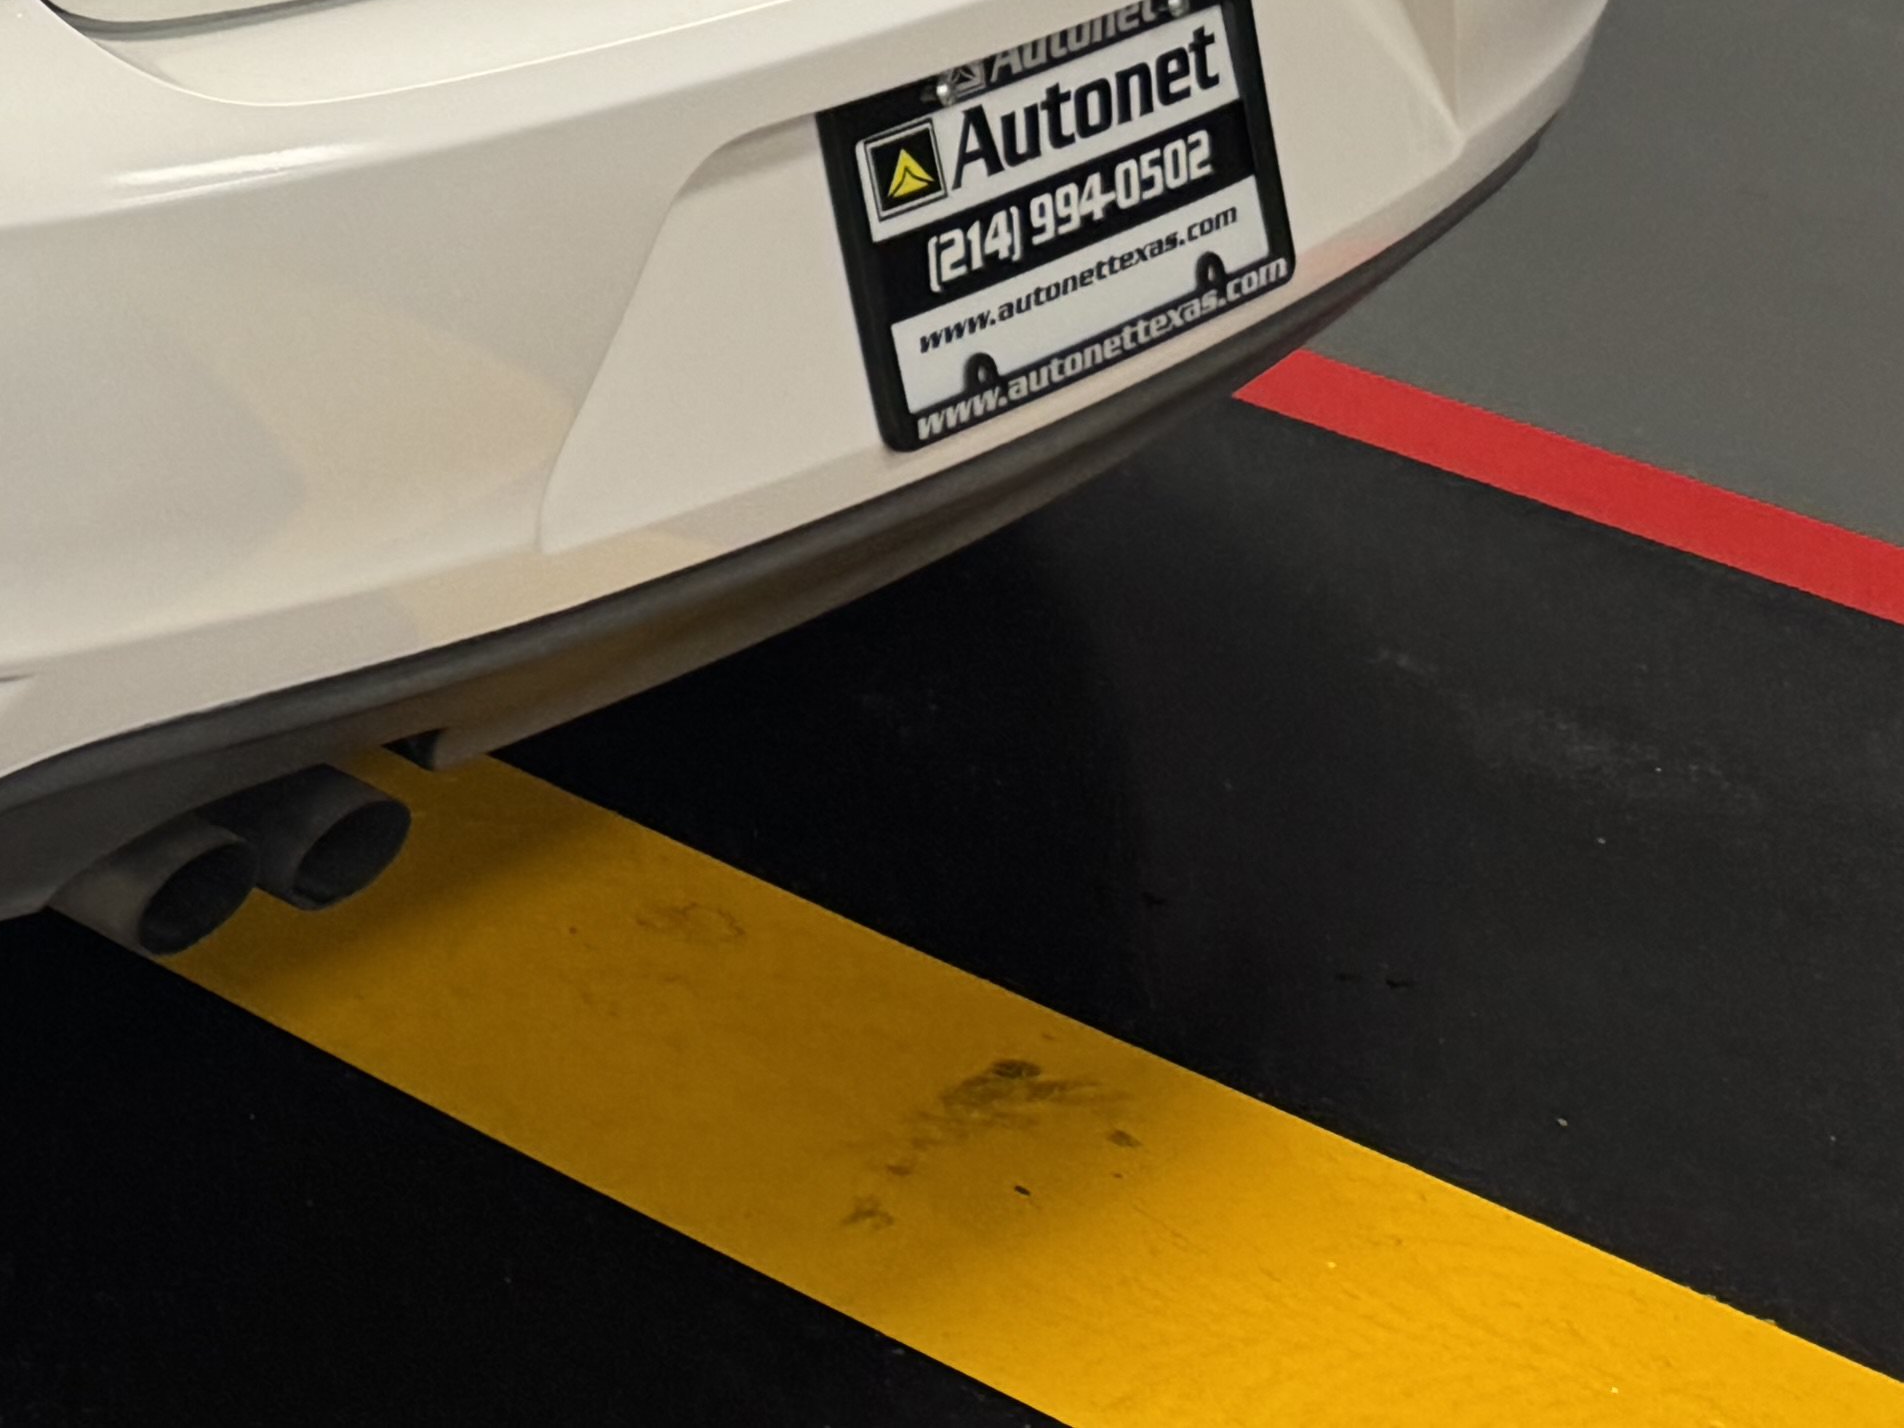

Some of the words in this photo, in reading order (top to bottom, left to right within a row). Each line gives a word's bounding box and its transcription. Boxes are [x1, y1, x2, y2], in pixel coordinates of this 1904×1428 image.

[950, 25, 1220, 191] Autonet
[919, 205, 1238, 355] www.autonettexas.com
[927, 206, 1022, 294] (214)
[1029, 129, 1214, 245] 994-0502
[917, 257, 1288, 441] www.autonettexas.com
